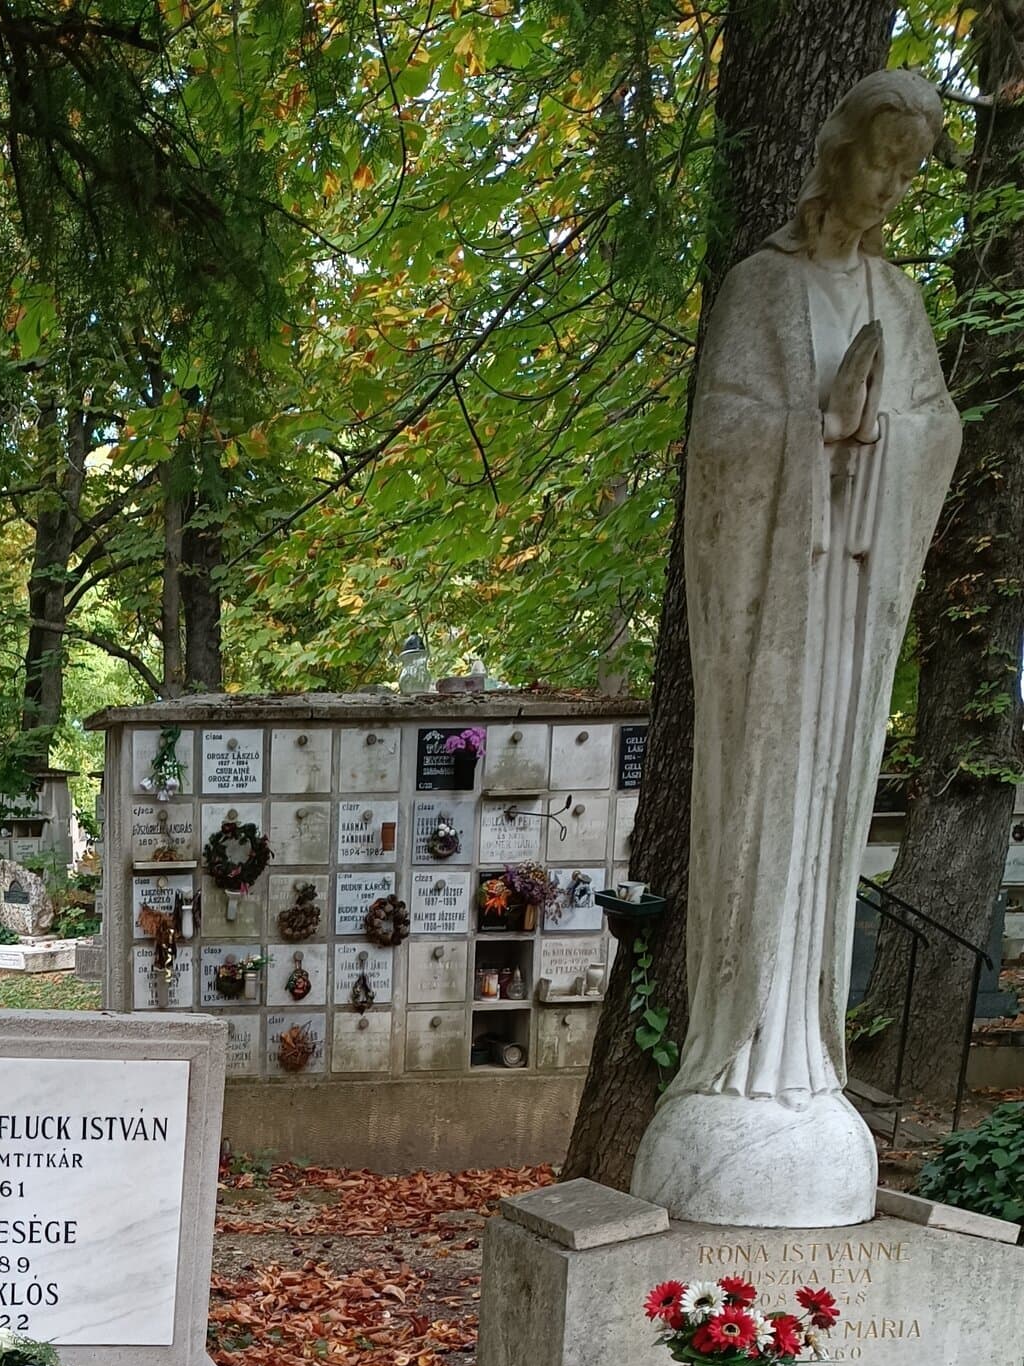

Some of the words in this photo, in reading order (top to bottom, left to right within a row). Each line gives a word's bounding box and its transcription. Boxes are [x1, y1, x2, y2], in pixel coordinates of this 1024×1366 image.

[206, 752, 228, 760] OROSZ
[231, 750, 260, 760] LÁSZLÓ
[233, 773, 257, 783] MÁRIA
[442, 885, 464, 896] JÓZSEF
[413, 912, 436, 921] HALMOS
[81, 1108, 169, 1142] ISTVÁN
